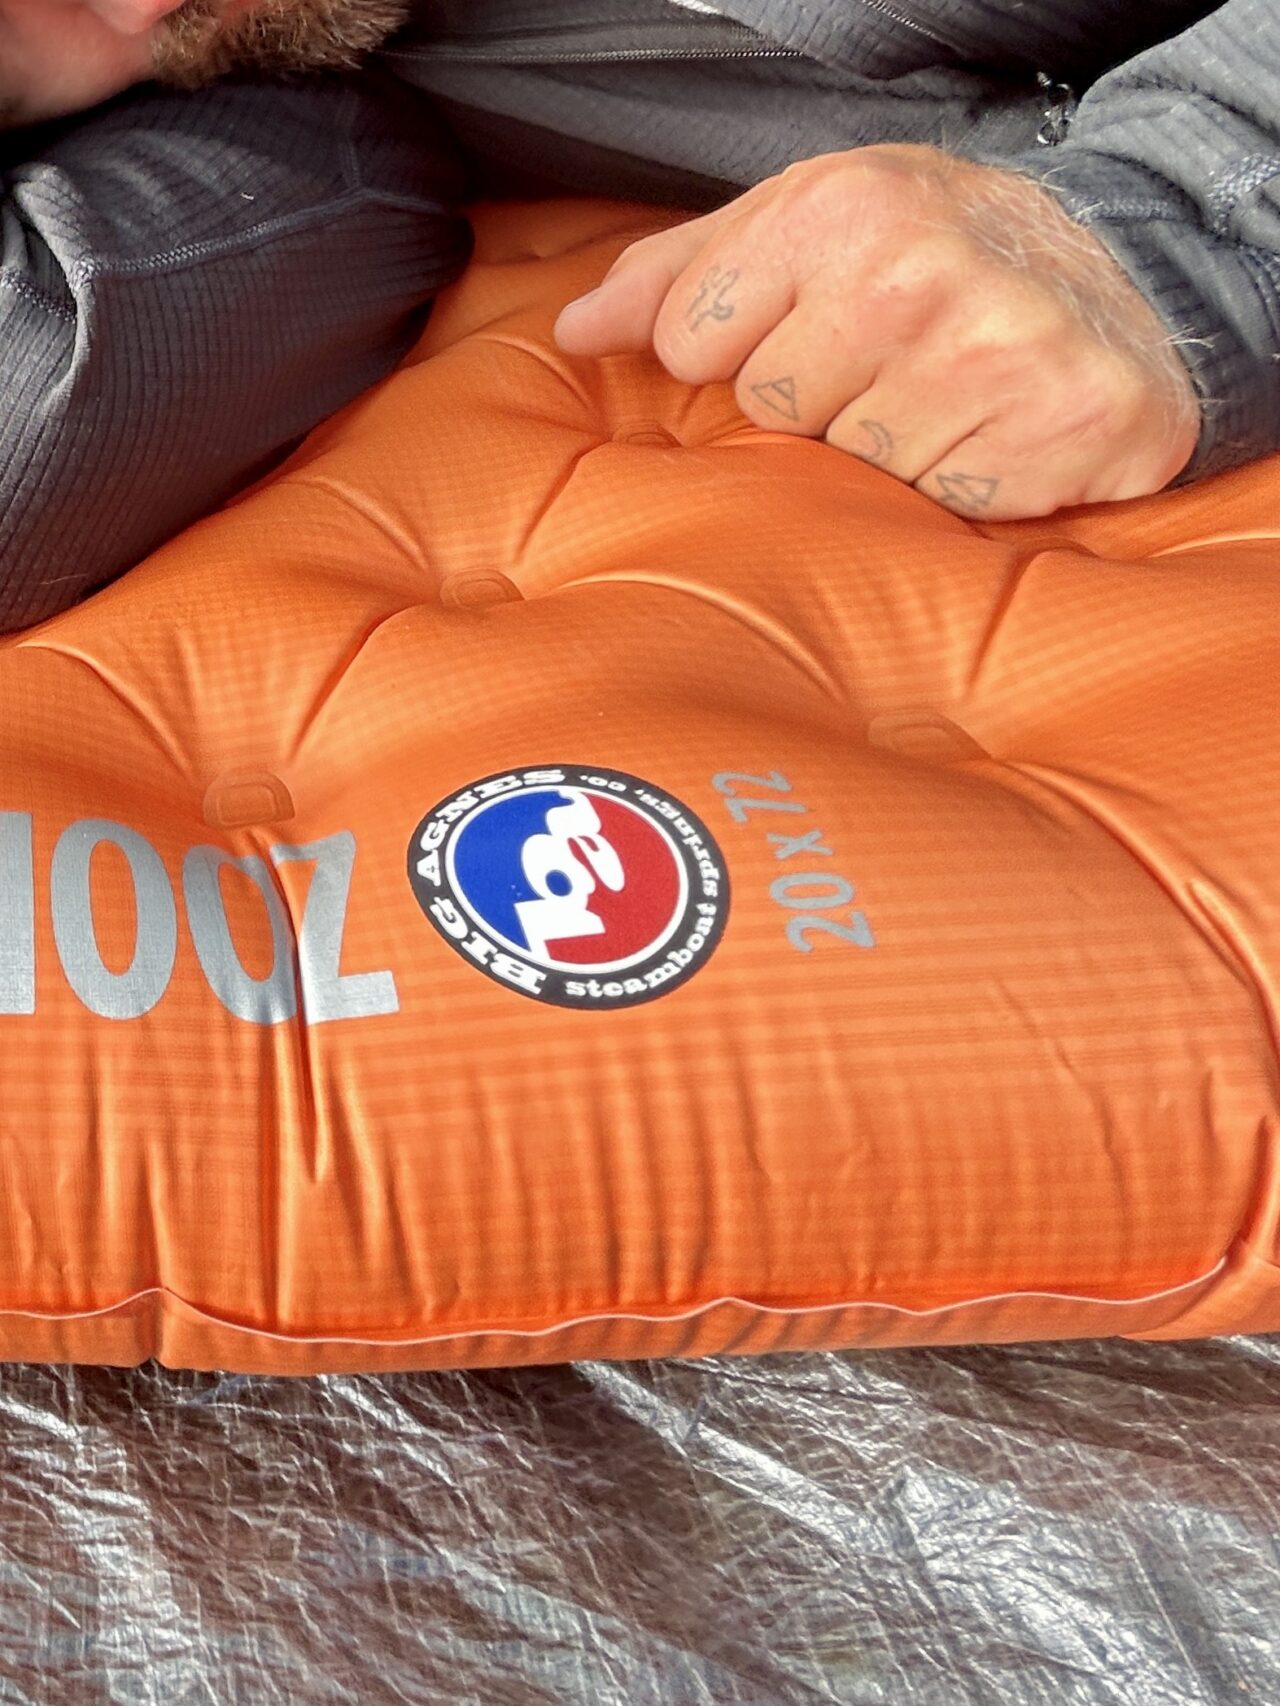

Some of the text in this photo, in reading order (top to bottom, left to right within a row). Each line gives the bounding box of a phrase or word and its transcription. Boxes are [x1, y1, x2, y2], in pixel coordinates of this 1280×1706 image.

[417, 769, 566, 995] BIG AGNES
[712, 770, 876, 953] 20 x 72
